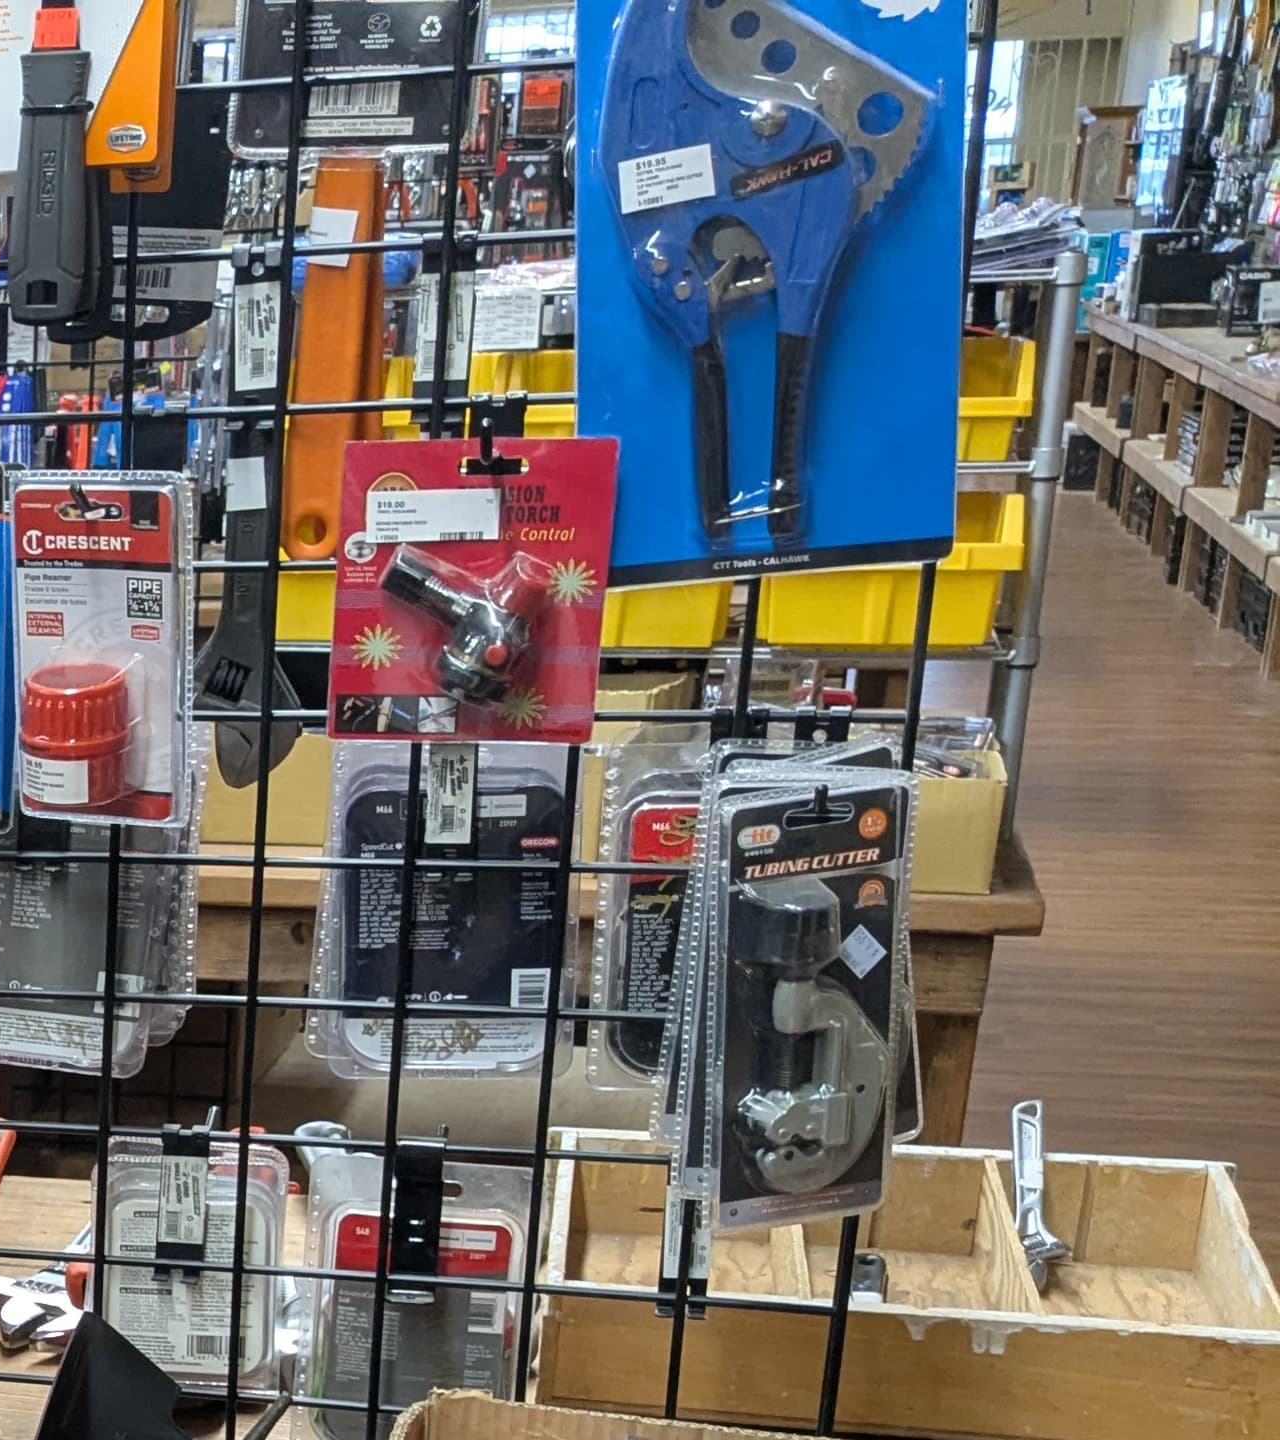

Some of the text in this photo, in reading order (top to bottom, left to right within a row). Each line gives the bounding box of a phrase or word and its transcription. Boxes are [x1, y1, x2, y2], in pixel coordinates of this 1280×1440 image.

[42, 150, 58, 217] RIDGID
[505, 506, 561, 523] TORCH
[520, 528, 576, 542] Control
[44, 535, 132, 551] CRESCENT
[712, 561, 730, 570] CTT
[733, 559, 757, 568] Tools
[24, 574, 72, 582] Pipe Reamer
[129, 579, 161, 594] PIPE
[521, 838, 558, 847] OREGON
[744, 847, 880, 881] TUBING CUTTER
